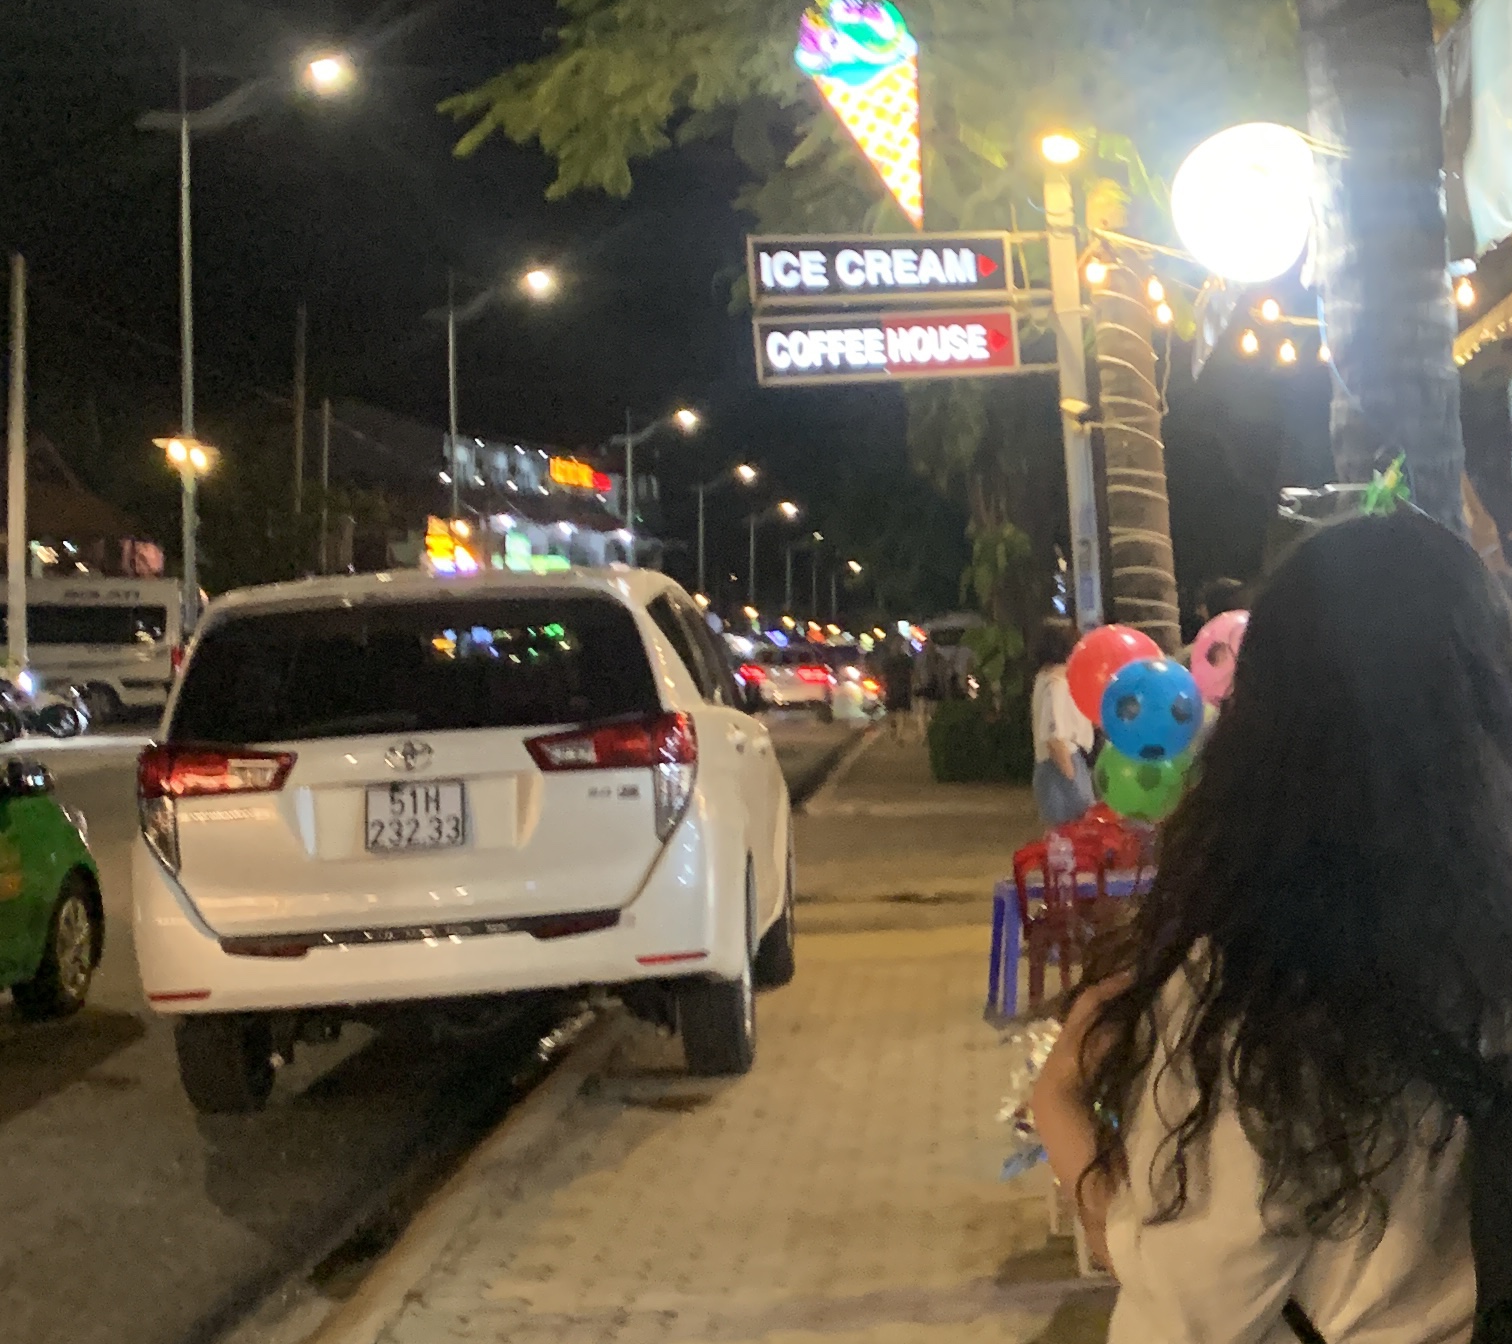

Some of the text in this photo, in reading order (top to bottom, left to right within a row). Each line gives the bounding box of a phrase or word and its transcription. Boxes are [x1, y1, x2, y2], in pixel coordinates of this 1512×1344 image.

[759, 248, 977, 288] ICE CREAM
[766, 324, 990, 370] COFFEE HOUSE
[389, 784, 441, 815] 51H
